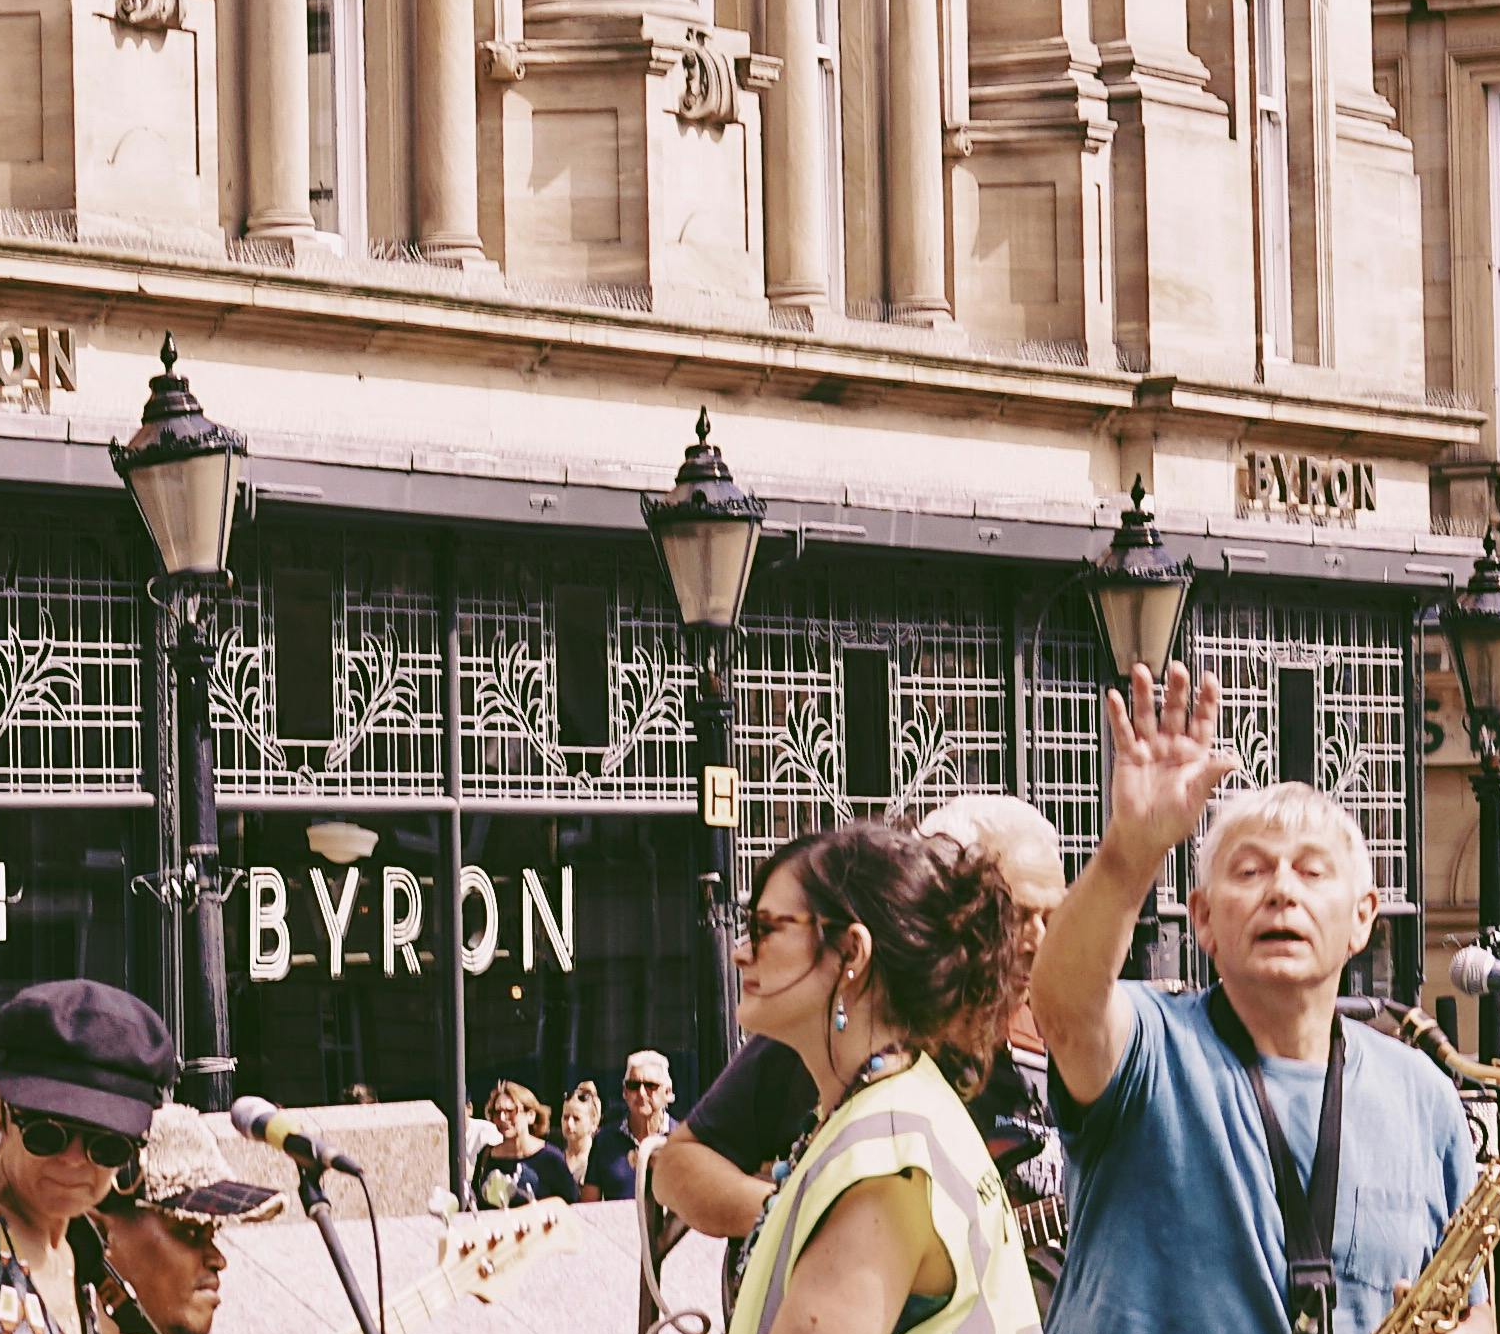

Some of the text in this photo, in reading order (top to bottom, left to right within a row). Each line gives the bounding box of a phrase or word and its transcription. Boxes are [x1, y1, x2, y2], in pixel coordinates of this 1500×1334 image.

[1247, 450, 1377, 512] BYRON
[712, 776, 733, 817] H
[250, 865, 573, 982] BYRON
